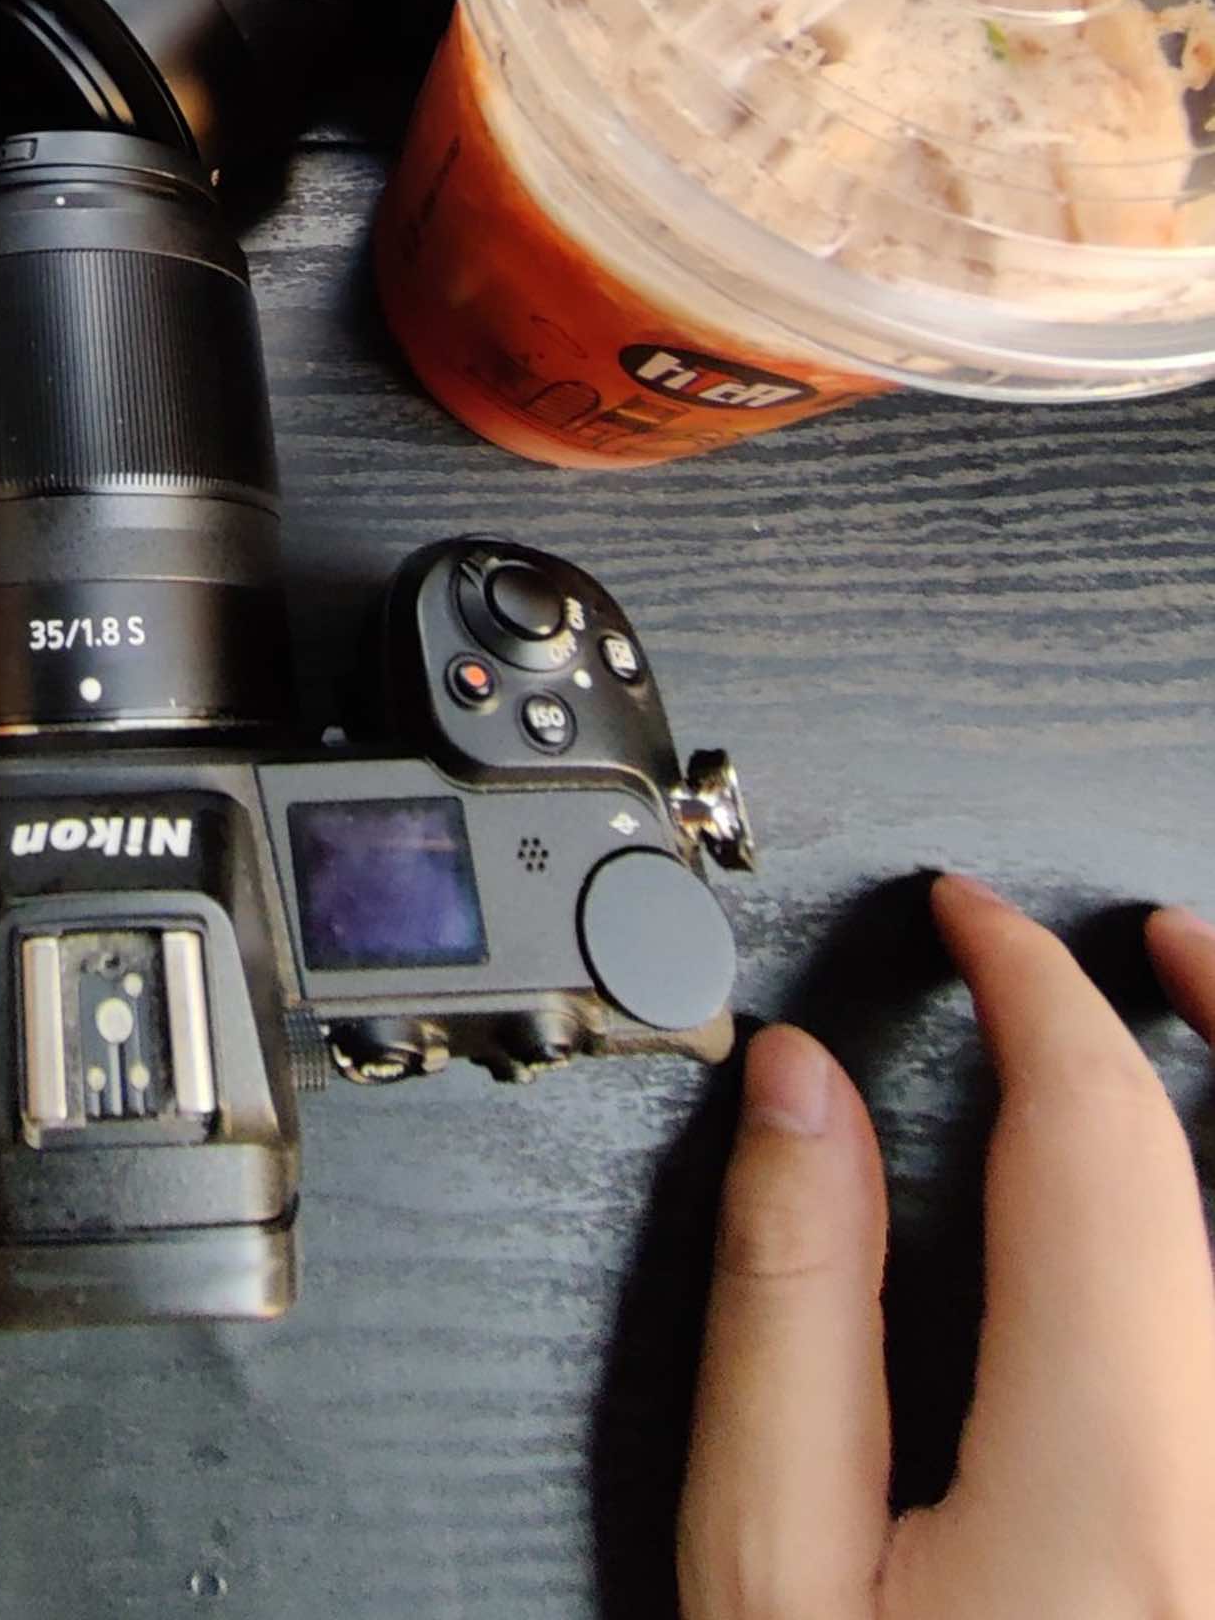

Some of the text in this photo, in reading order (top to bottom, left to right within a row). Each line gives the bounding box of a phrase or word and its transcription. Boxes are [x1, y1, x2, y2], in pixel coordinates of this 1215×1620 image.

[28, 615, 146, 650] 35/1.8 S
[527, 700, 567, 728] ISO
[11, 815, 193, 857] Nikon
